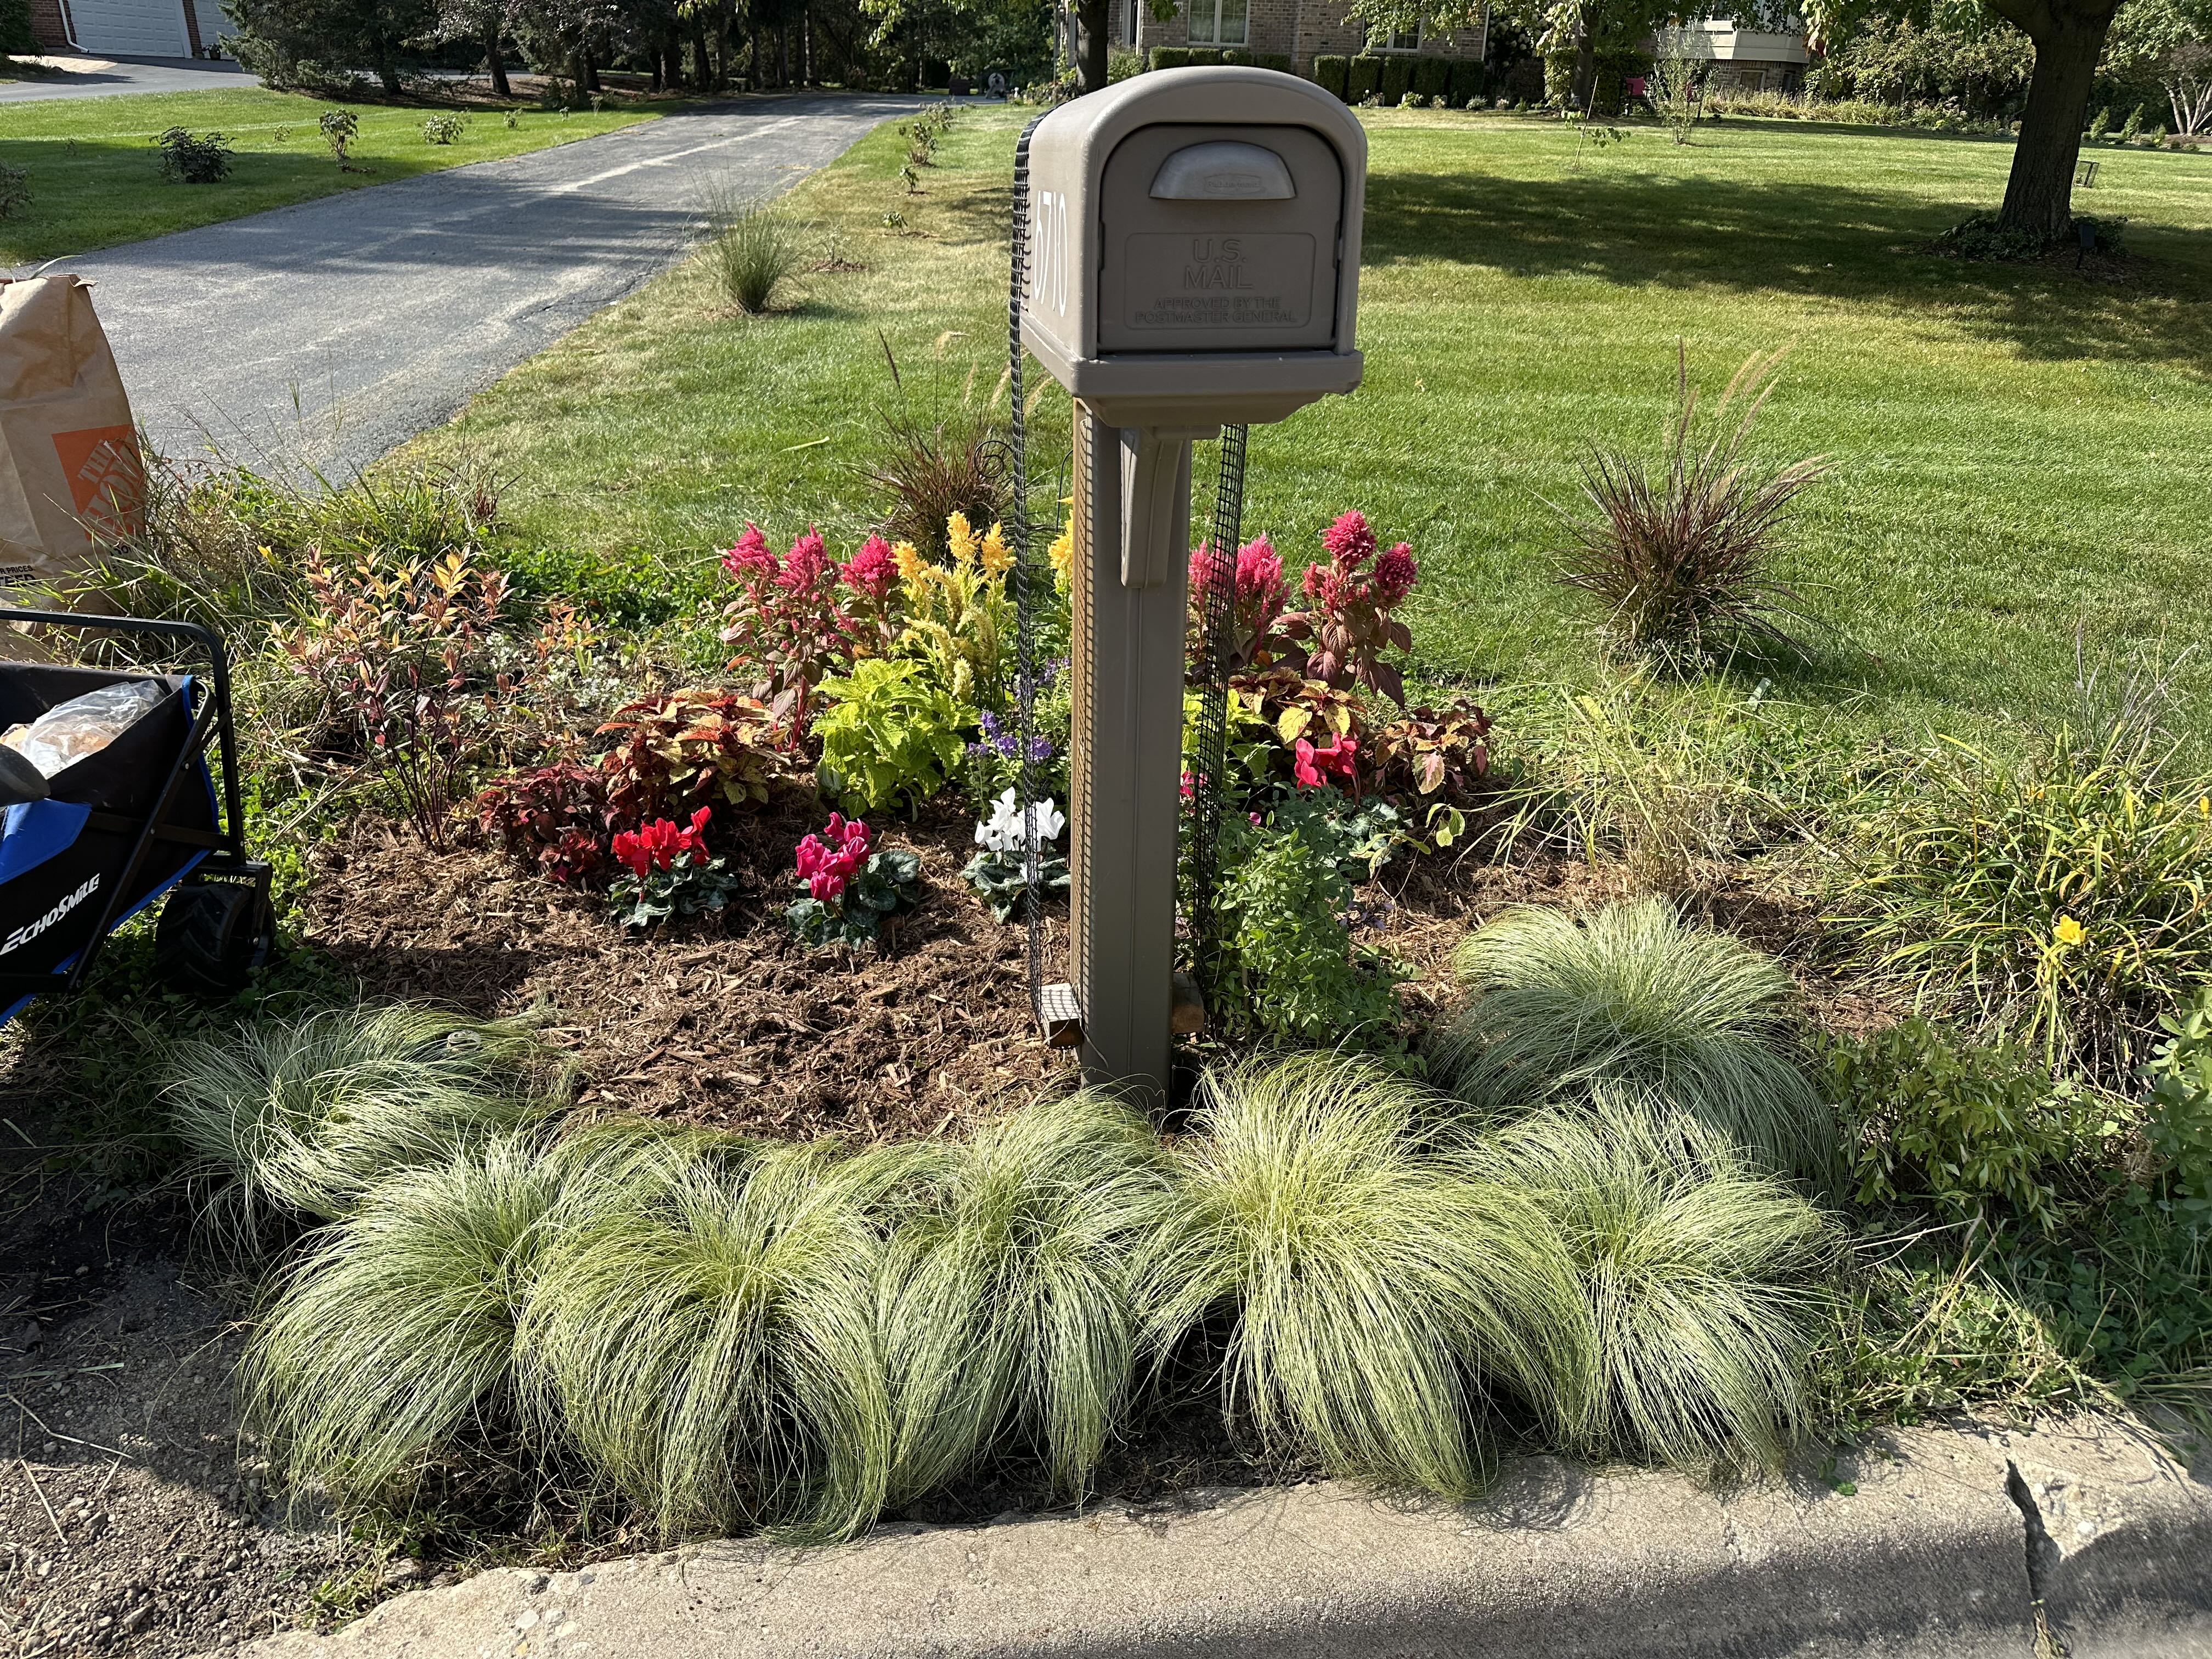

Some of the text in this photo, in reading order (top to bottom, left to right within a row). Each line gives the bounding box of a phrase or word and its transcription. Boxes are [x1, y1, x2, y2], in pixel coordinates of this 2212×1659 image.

[1034, 190, 1068, 318] 6710
[1193, 239, 1247, 263] U.S.
[1184, 265, 1254, 290] MAIL
[1154, 296, 1282, 311] APPROVED BY THE
[1135, 310, 1298, 324] POSTMASTER GENERAL
